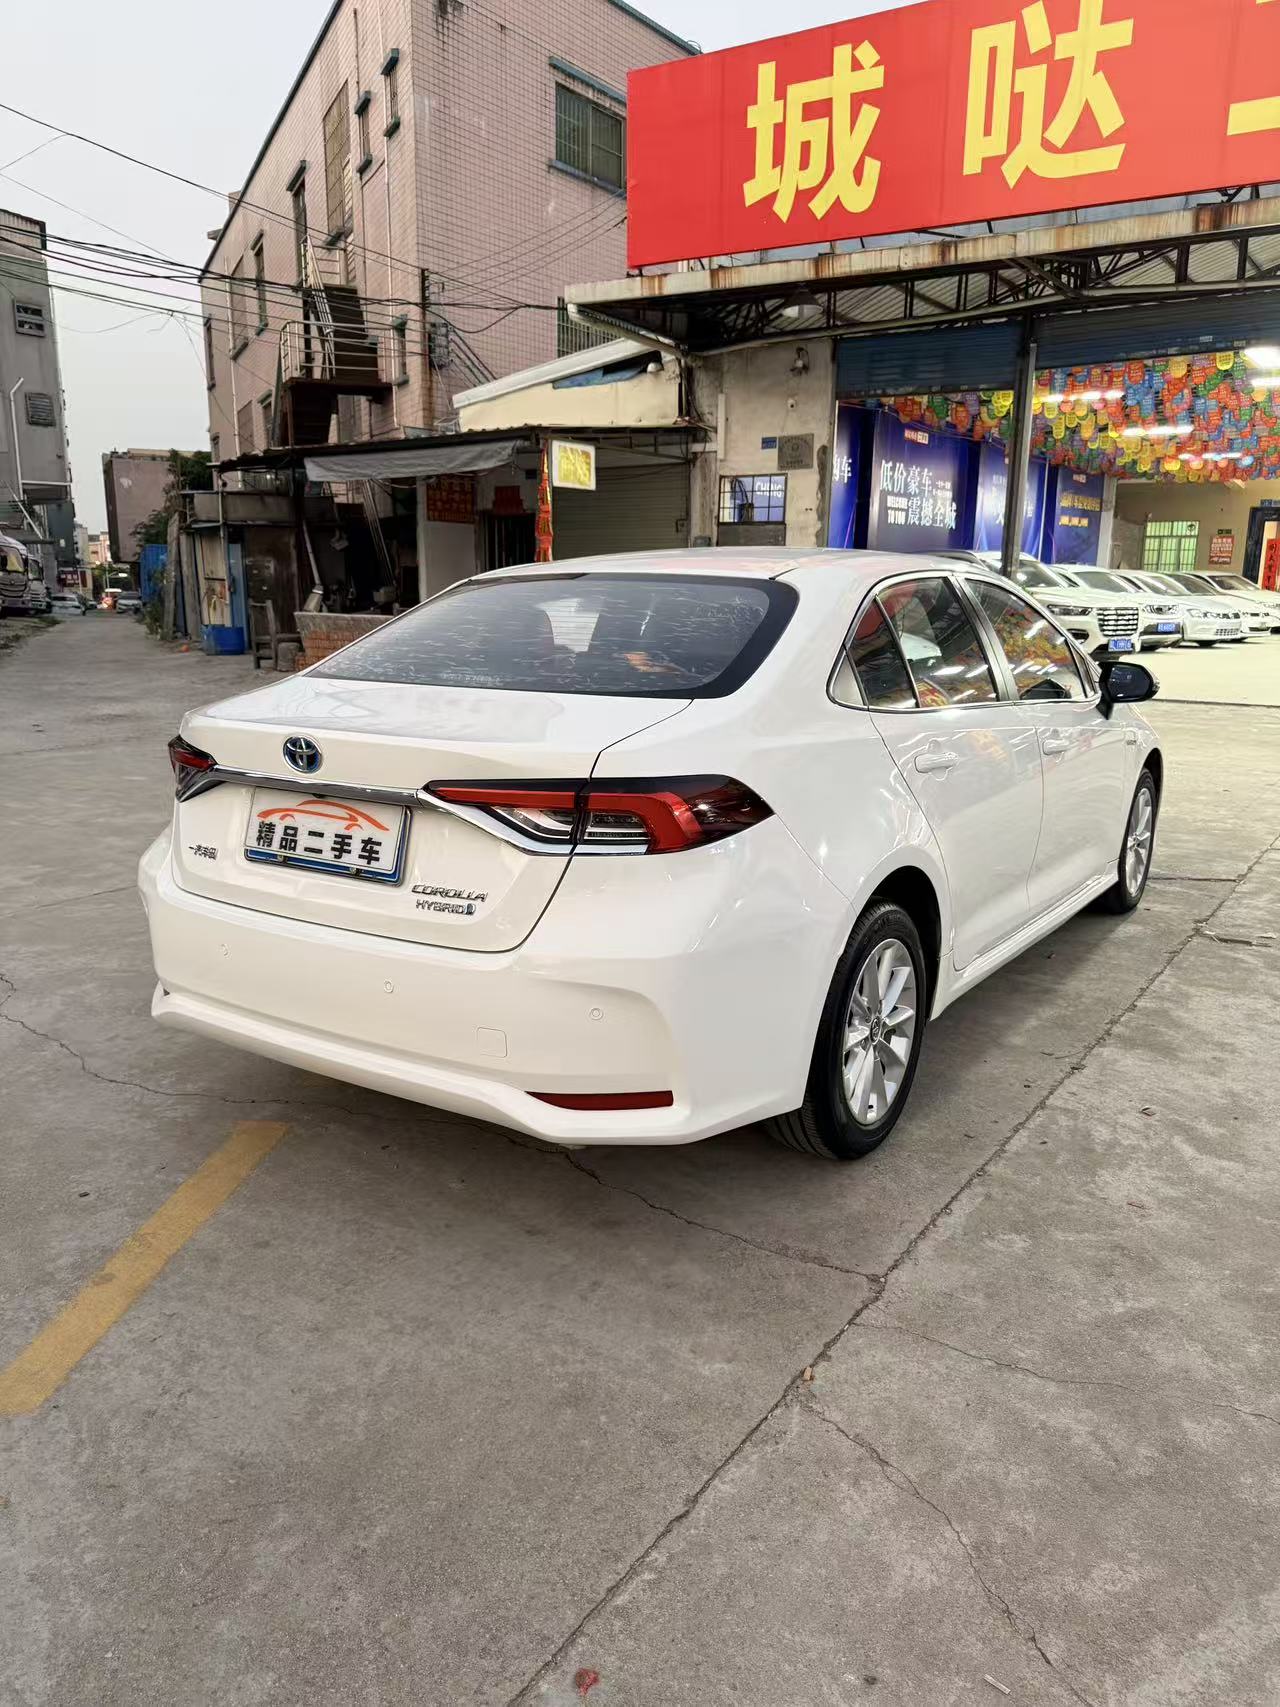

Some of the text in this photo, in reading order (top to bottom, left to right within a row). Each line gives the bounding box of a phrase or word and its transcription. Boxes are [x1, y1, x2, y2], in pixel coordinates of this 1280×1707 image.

[880, 459, 932, 497] 低价豪车
[907, 497, 957, 530] 震撼全城
[255, 820, 382, 865] 精品二手车
[411, 884, 489, 903] COROLLA
[416, 898, 465, 915] HYBRID
